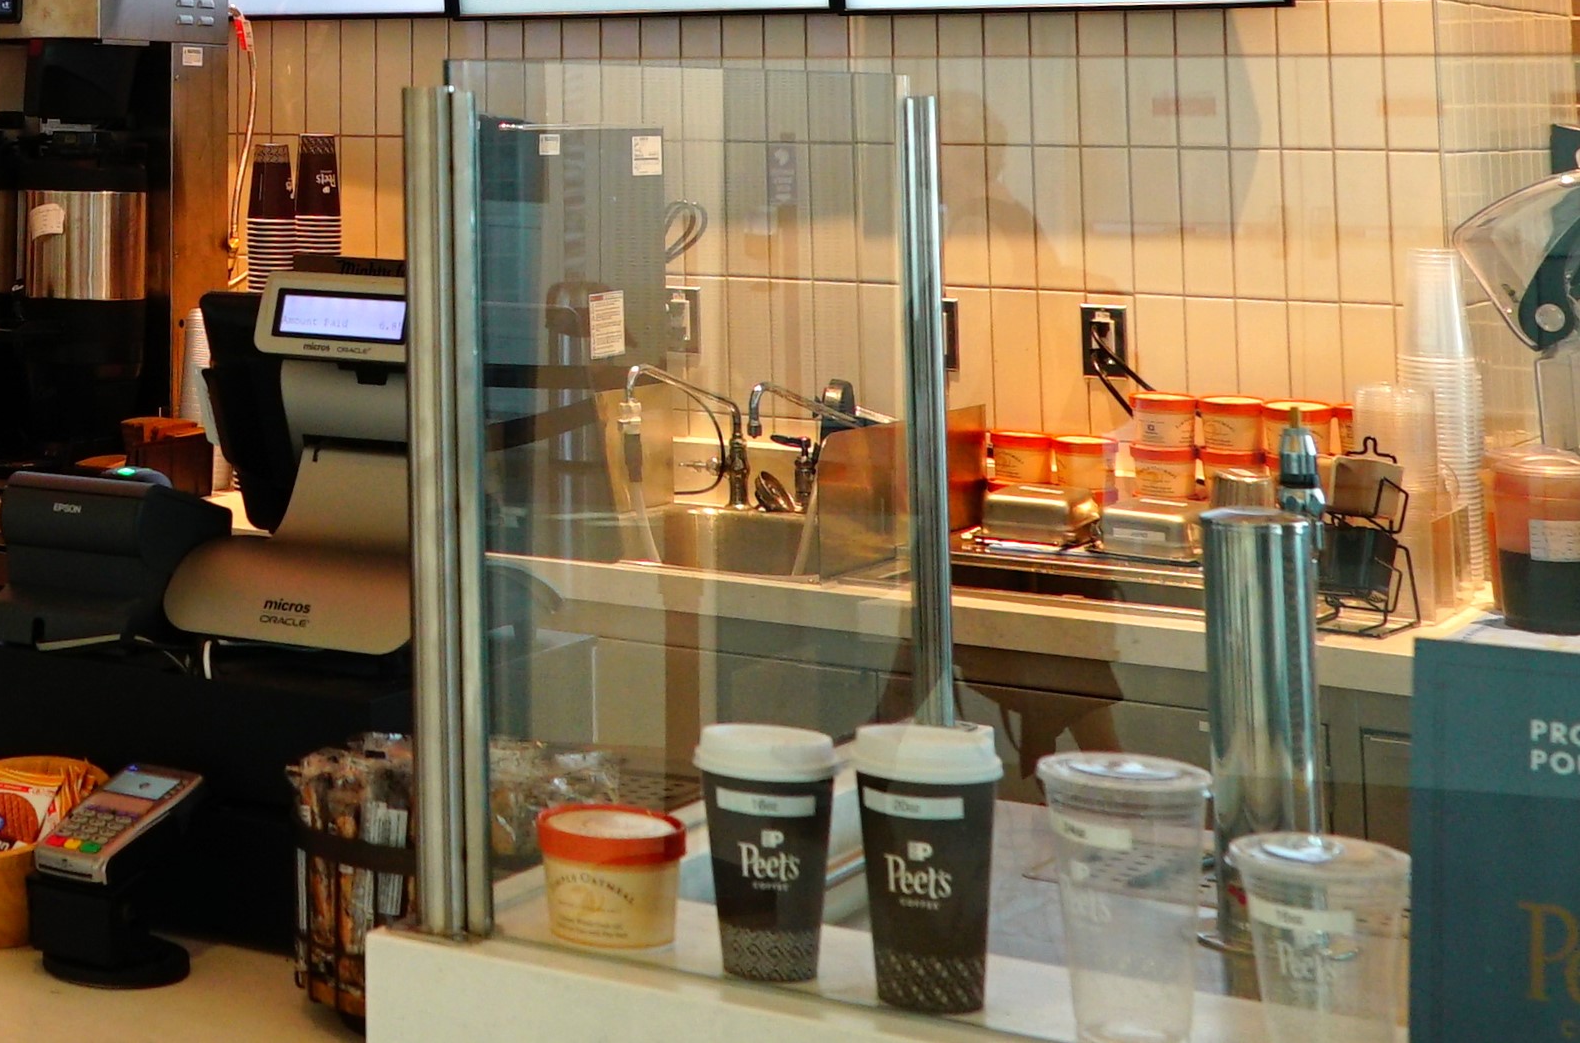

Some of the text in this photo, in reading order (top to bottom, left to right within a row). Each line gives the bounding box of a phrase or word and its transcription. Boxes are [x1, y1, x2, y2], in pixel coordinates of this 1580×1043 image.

[303, 342, 330, 351] micros
[53, 502, 82, 514] EPSON
[263, 598, 311, 613] micros
[259, 614, 307, 627] ORACLE
[1530, 749, 1580, 775] PO
[737, 841, 800, 882] Peet's
[884, 853, 952, 899] Peet's
